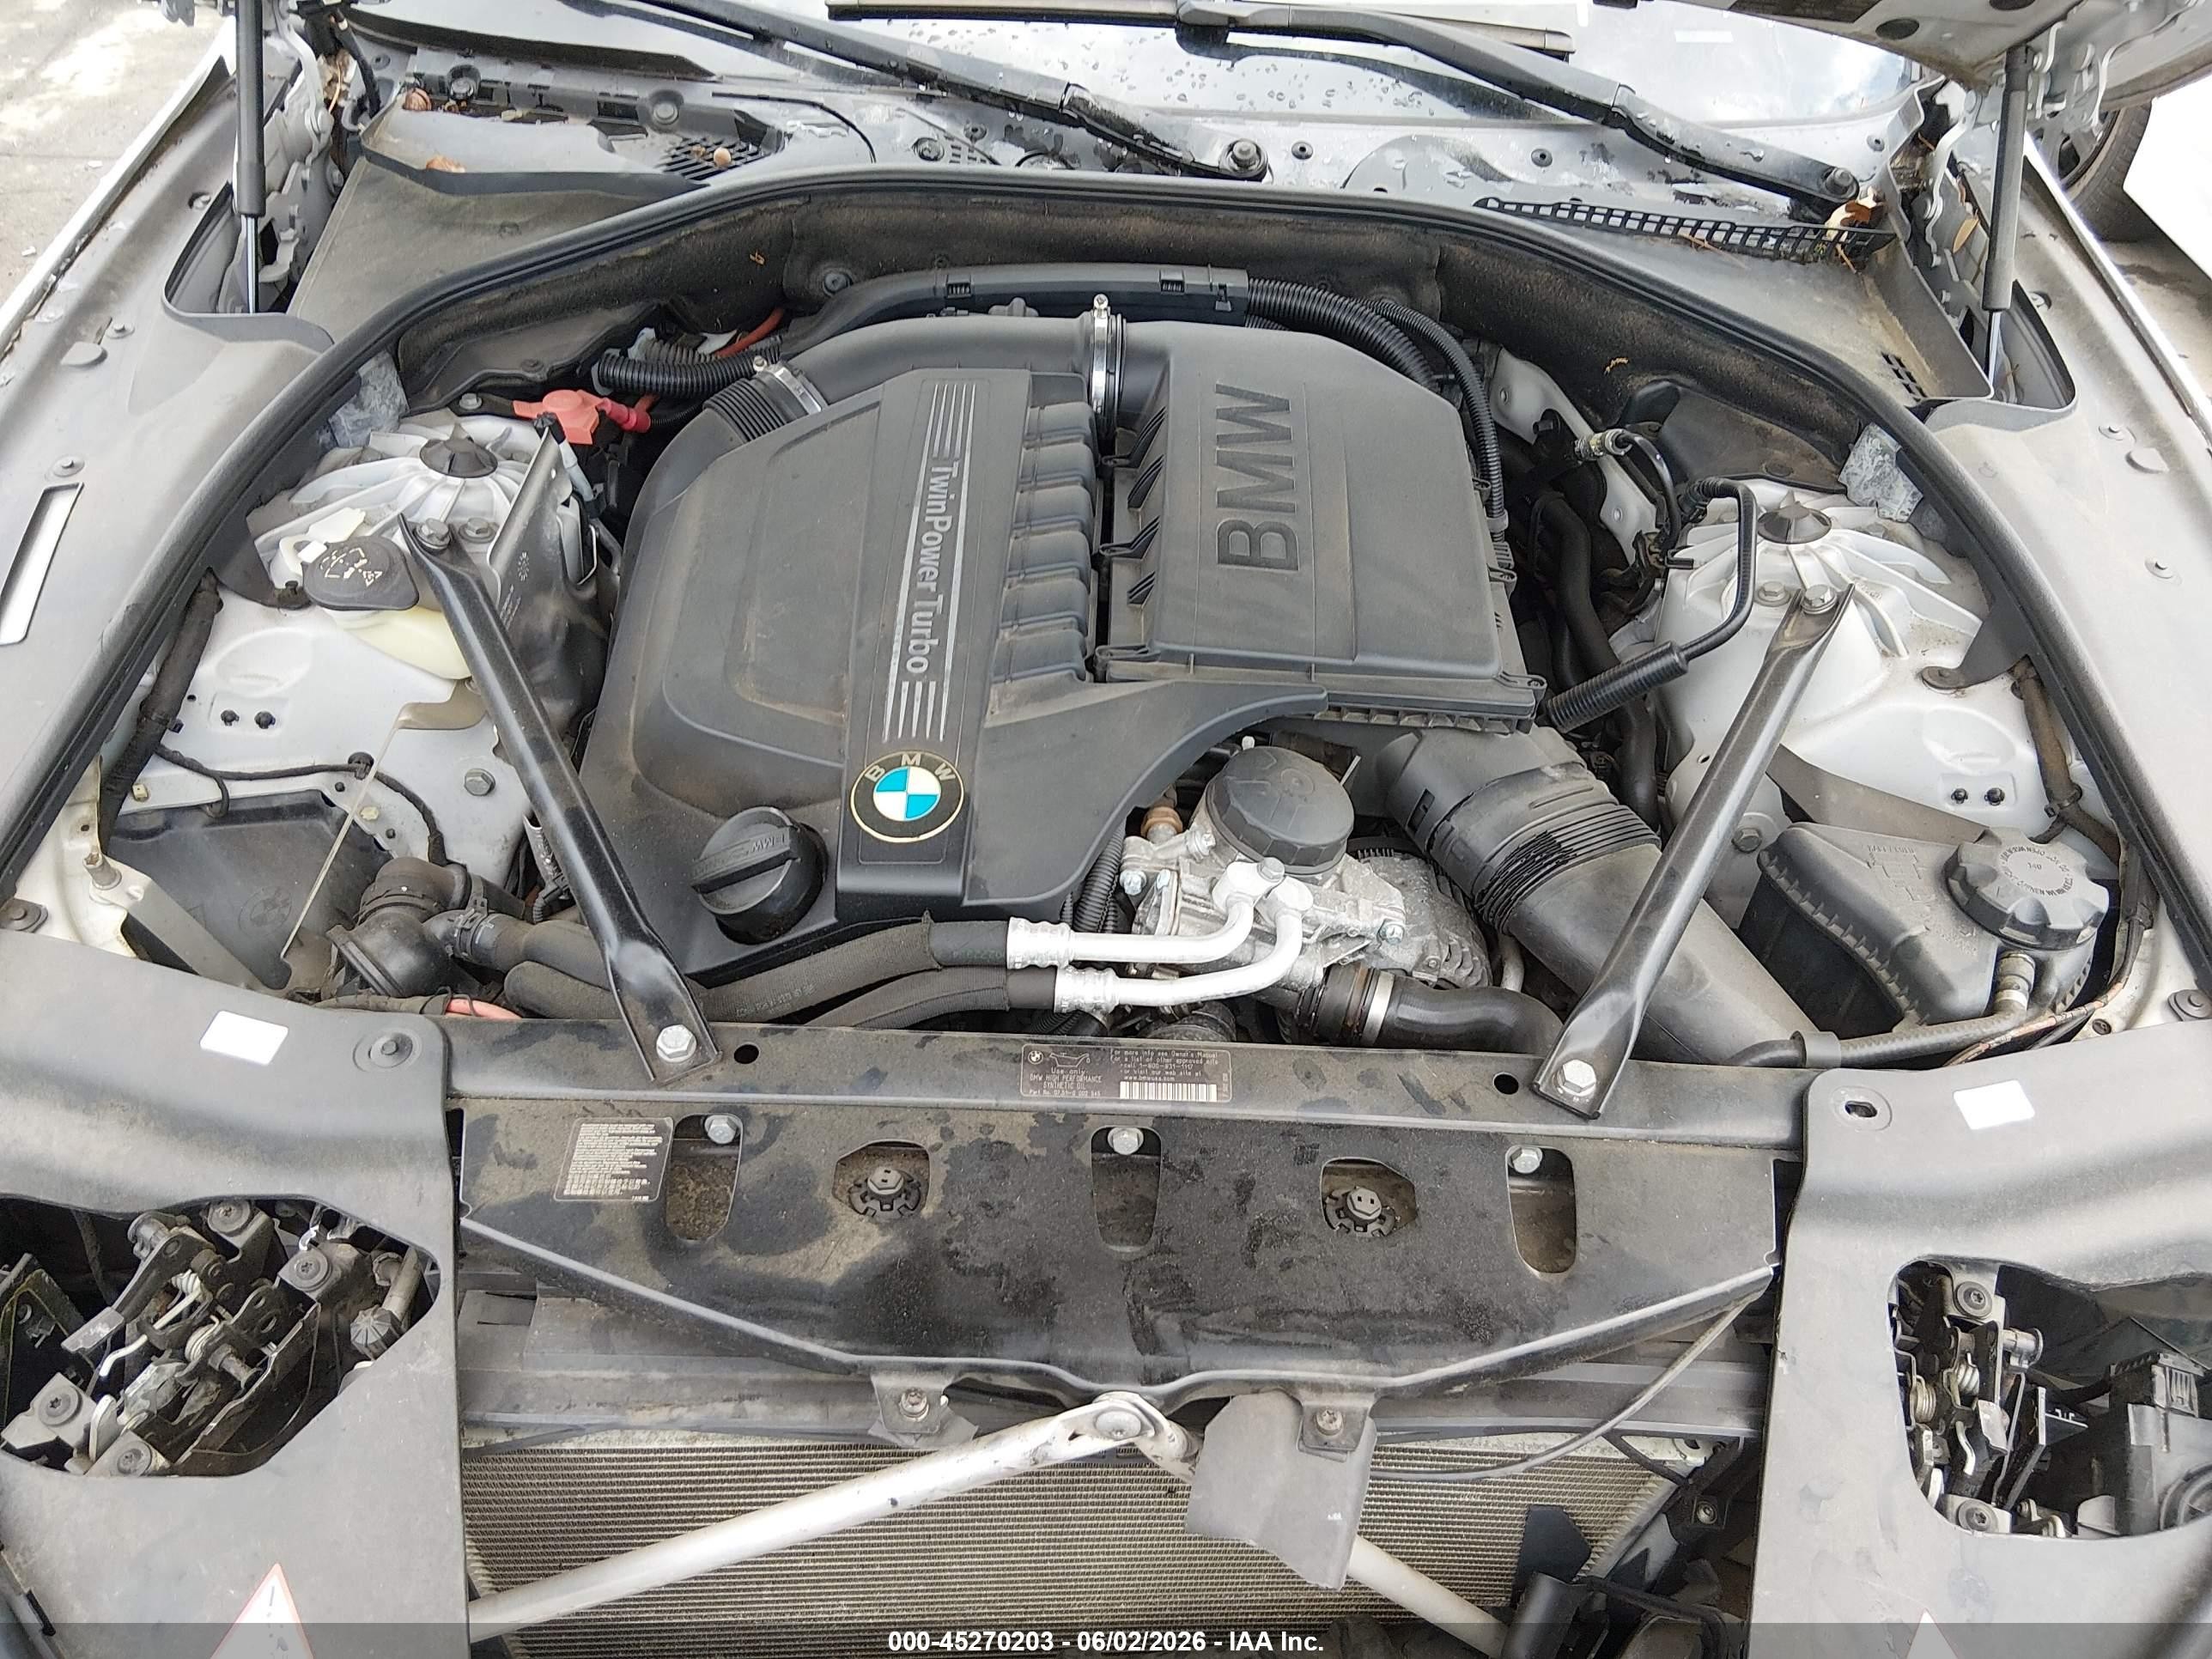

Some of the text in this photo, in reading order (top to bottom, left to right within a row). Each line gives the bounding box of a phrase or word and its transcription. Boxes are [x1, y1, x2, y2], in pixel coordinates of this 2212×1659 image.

[1215, 383, 1299, 571] BMW
[864, 753, 957, 782] BMW
[1030, 1073, 1043, 1081] BMW
[1062, 1074, 1103, 1083] PERFORMANCE
[1043, 1081, 1074, 1090] SYNTHETIC
